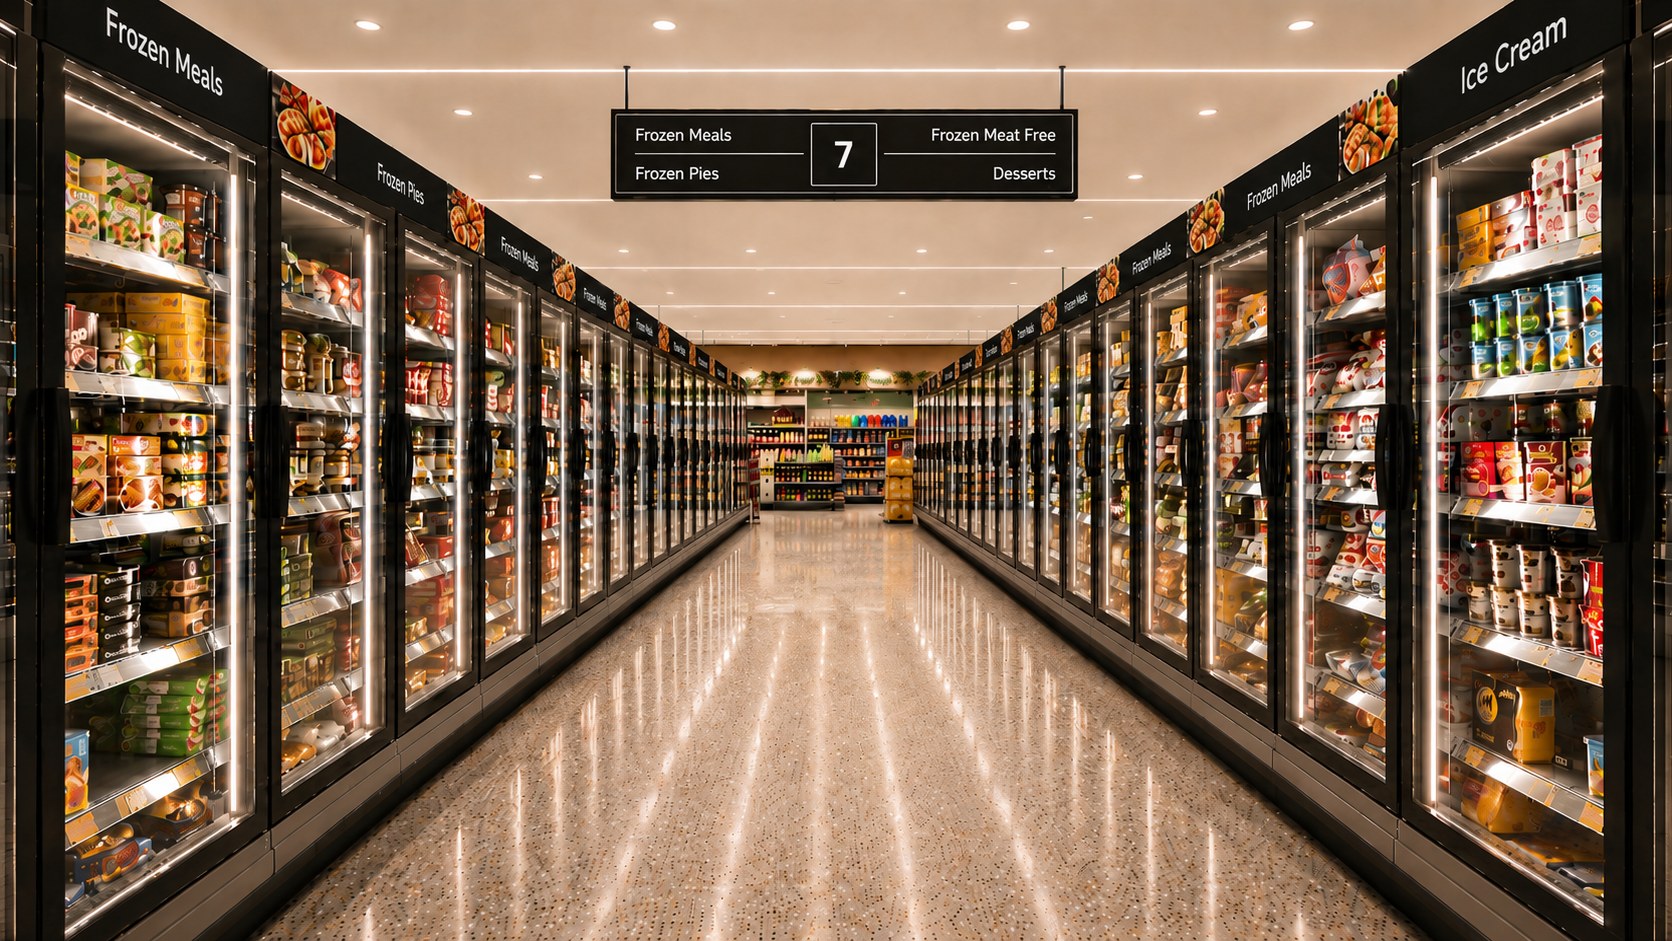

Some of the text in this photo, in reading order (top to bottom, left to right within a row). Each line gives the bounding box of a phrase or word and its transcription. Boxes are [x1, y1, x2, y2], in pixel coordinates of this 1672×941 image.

[106, 7, 224, 96] Frozen Meals
[1461, 15, 1567, 95] Ice Cream
[635, 127, 732, 142] Frozen Meals
[931, 127, 1057, 142] Frozen Meat Free
[834, 140, 853, 169] 7
[377, 161, 425, 205] Frozen Pies
[635, 166, 720, 181] Frozen Pies
[993, 166, 1056, 181] Desserts
[1247, 161, 1312, 211] Frozen Meals
[500, 235, 540, 272] Frozen Meals
[1152, 241, 1172, 264] Meals
